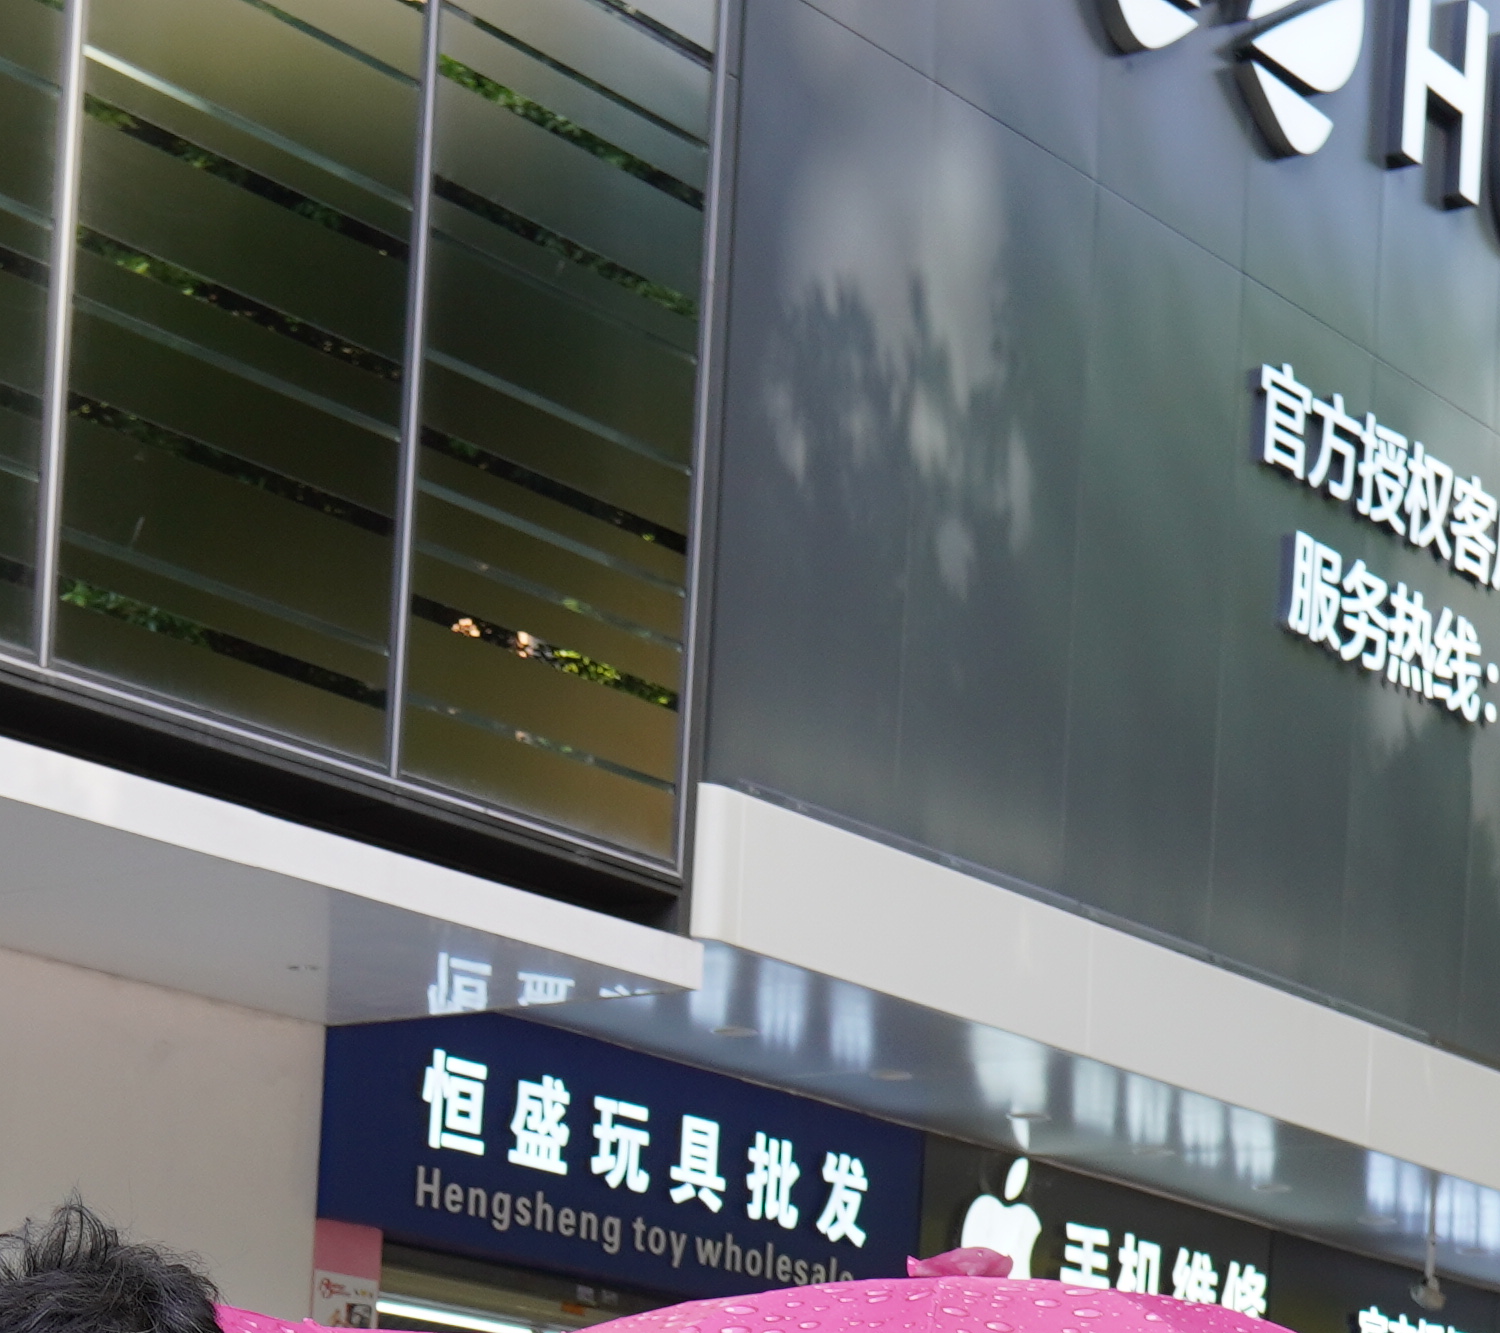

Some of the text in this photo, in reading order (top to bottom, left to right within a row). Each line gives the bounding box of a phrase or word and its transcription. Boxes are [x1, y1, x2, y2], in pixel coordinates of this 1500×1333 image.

[415, 1166, 621, 1254] Hengsheng
[633, 1216, 686, 1276] toy
[423, 1048, 868, 1248] 恒盛玩具批发
